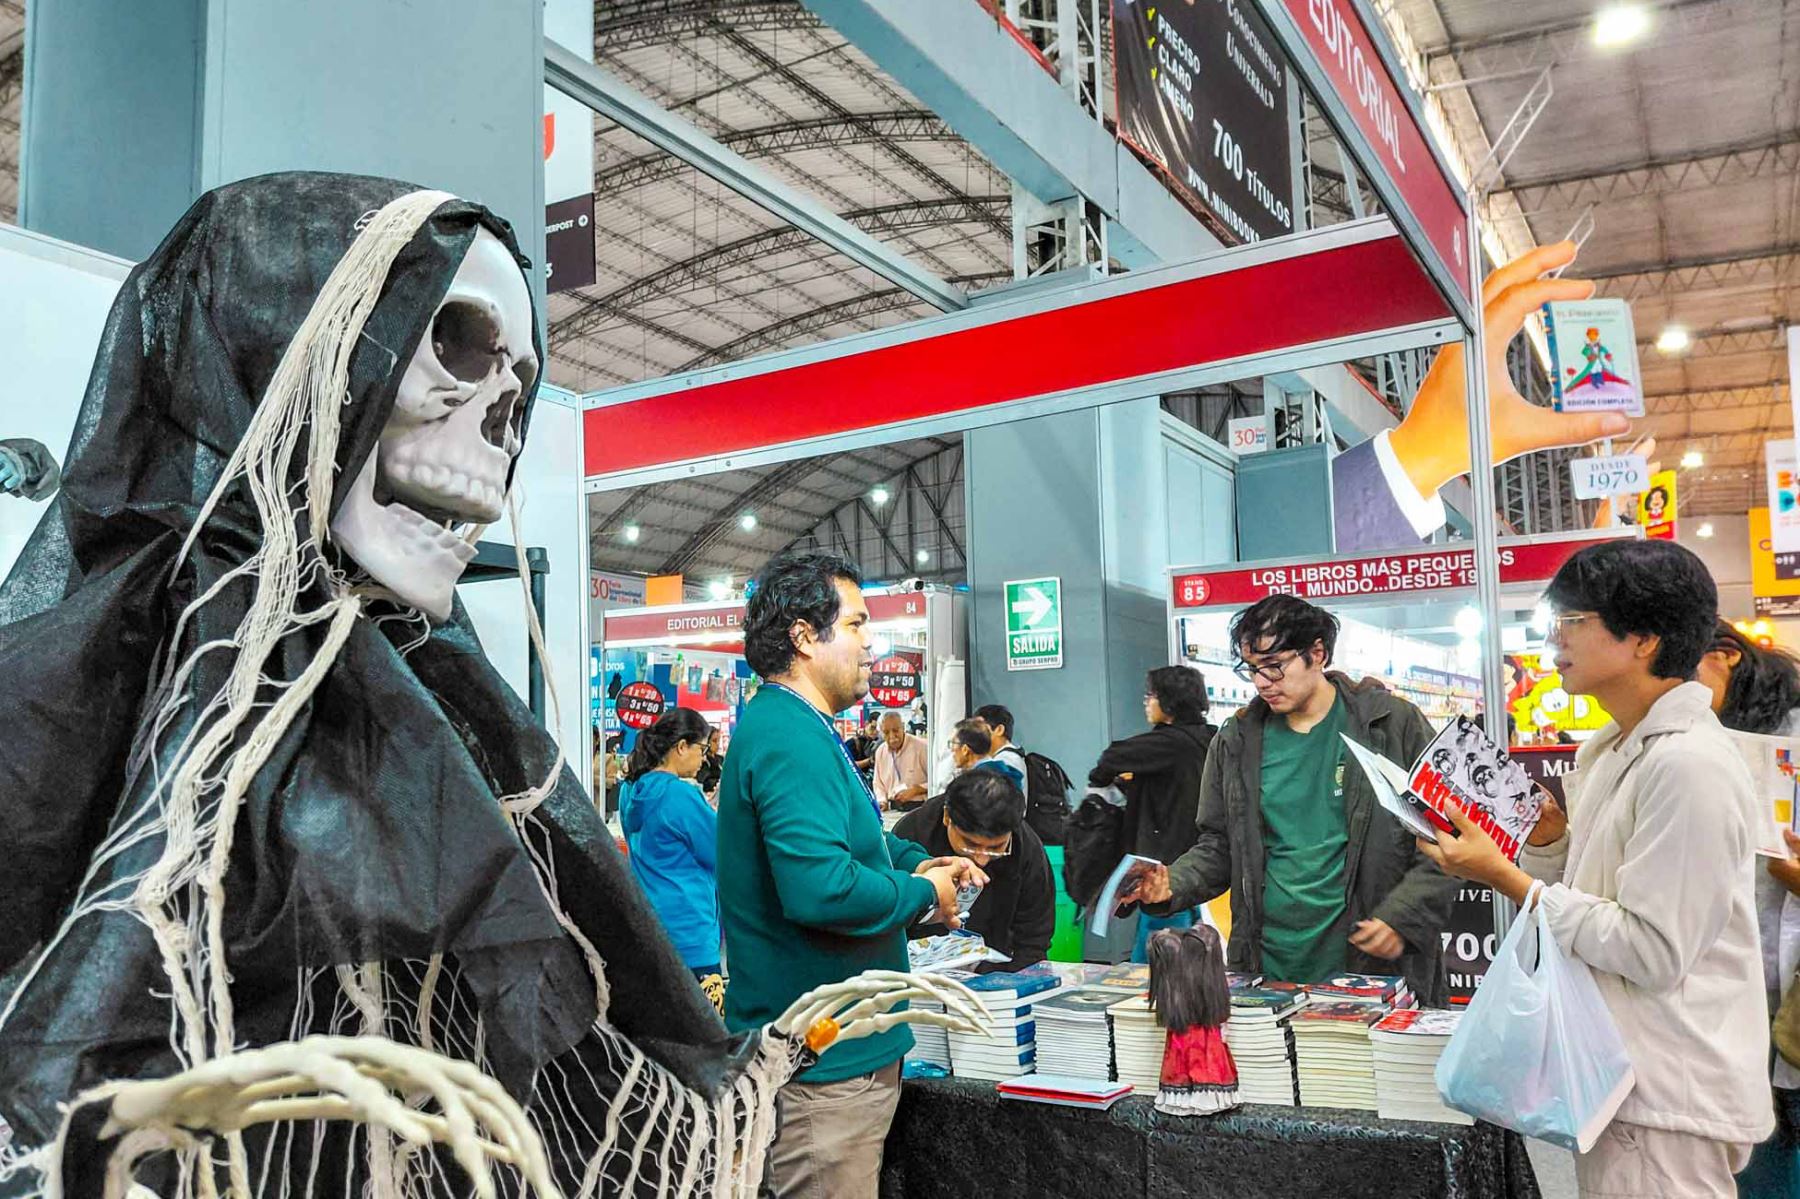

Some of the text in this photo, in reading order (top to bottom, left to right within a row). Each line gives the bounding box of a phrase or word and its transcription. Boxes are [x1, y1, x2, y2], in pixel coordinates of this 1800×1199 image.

[1158, 13, 1200, 74] PRECISO
[1158, 43, 1192, 92] CLARO
[1159, 73, 1194, 122] AMENO
[1309, 0, 1406, 174] EDITORIAL
[1213, 118, 1290, 229] 700 TÍTULOS
[1588, 470, 1638, 489] 1970
[1252, 550, 1515, 587] LOS LIBROS MÁS PEQUES
[1184, 587, 1205, 601] 85
[1268, 584, 1303, 599] DEL
[905, 601, 917, 614] 84
[667, 614, 740, 632] EDITORIAL EL
[1013, 635, 1056, 654] SALIDA
